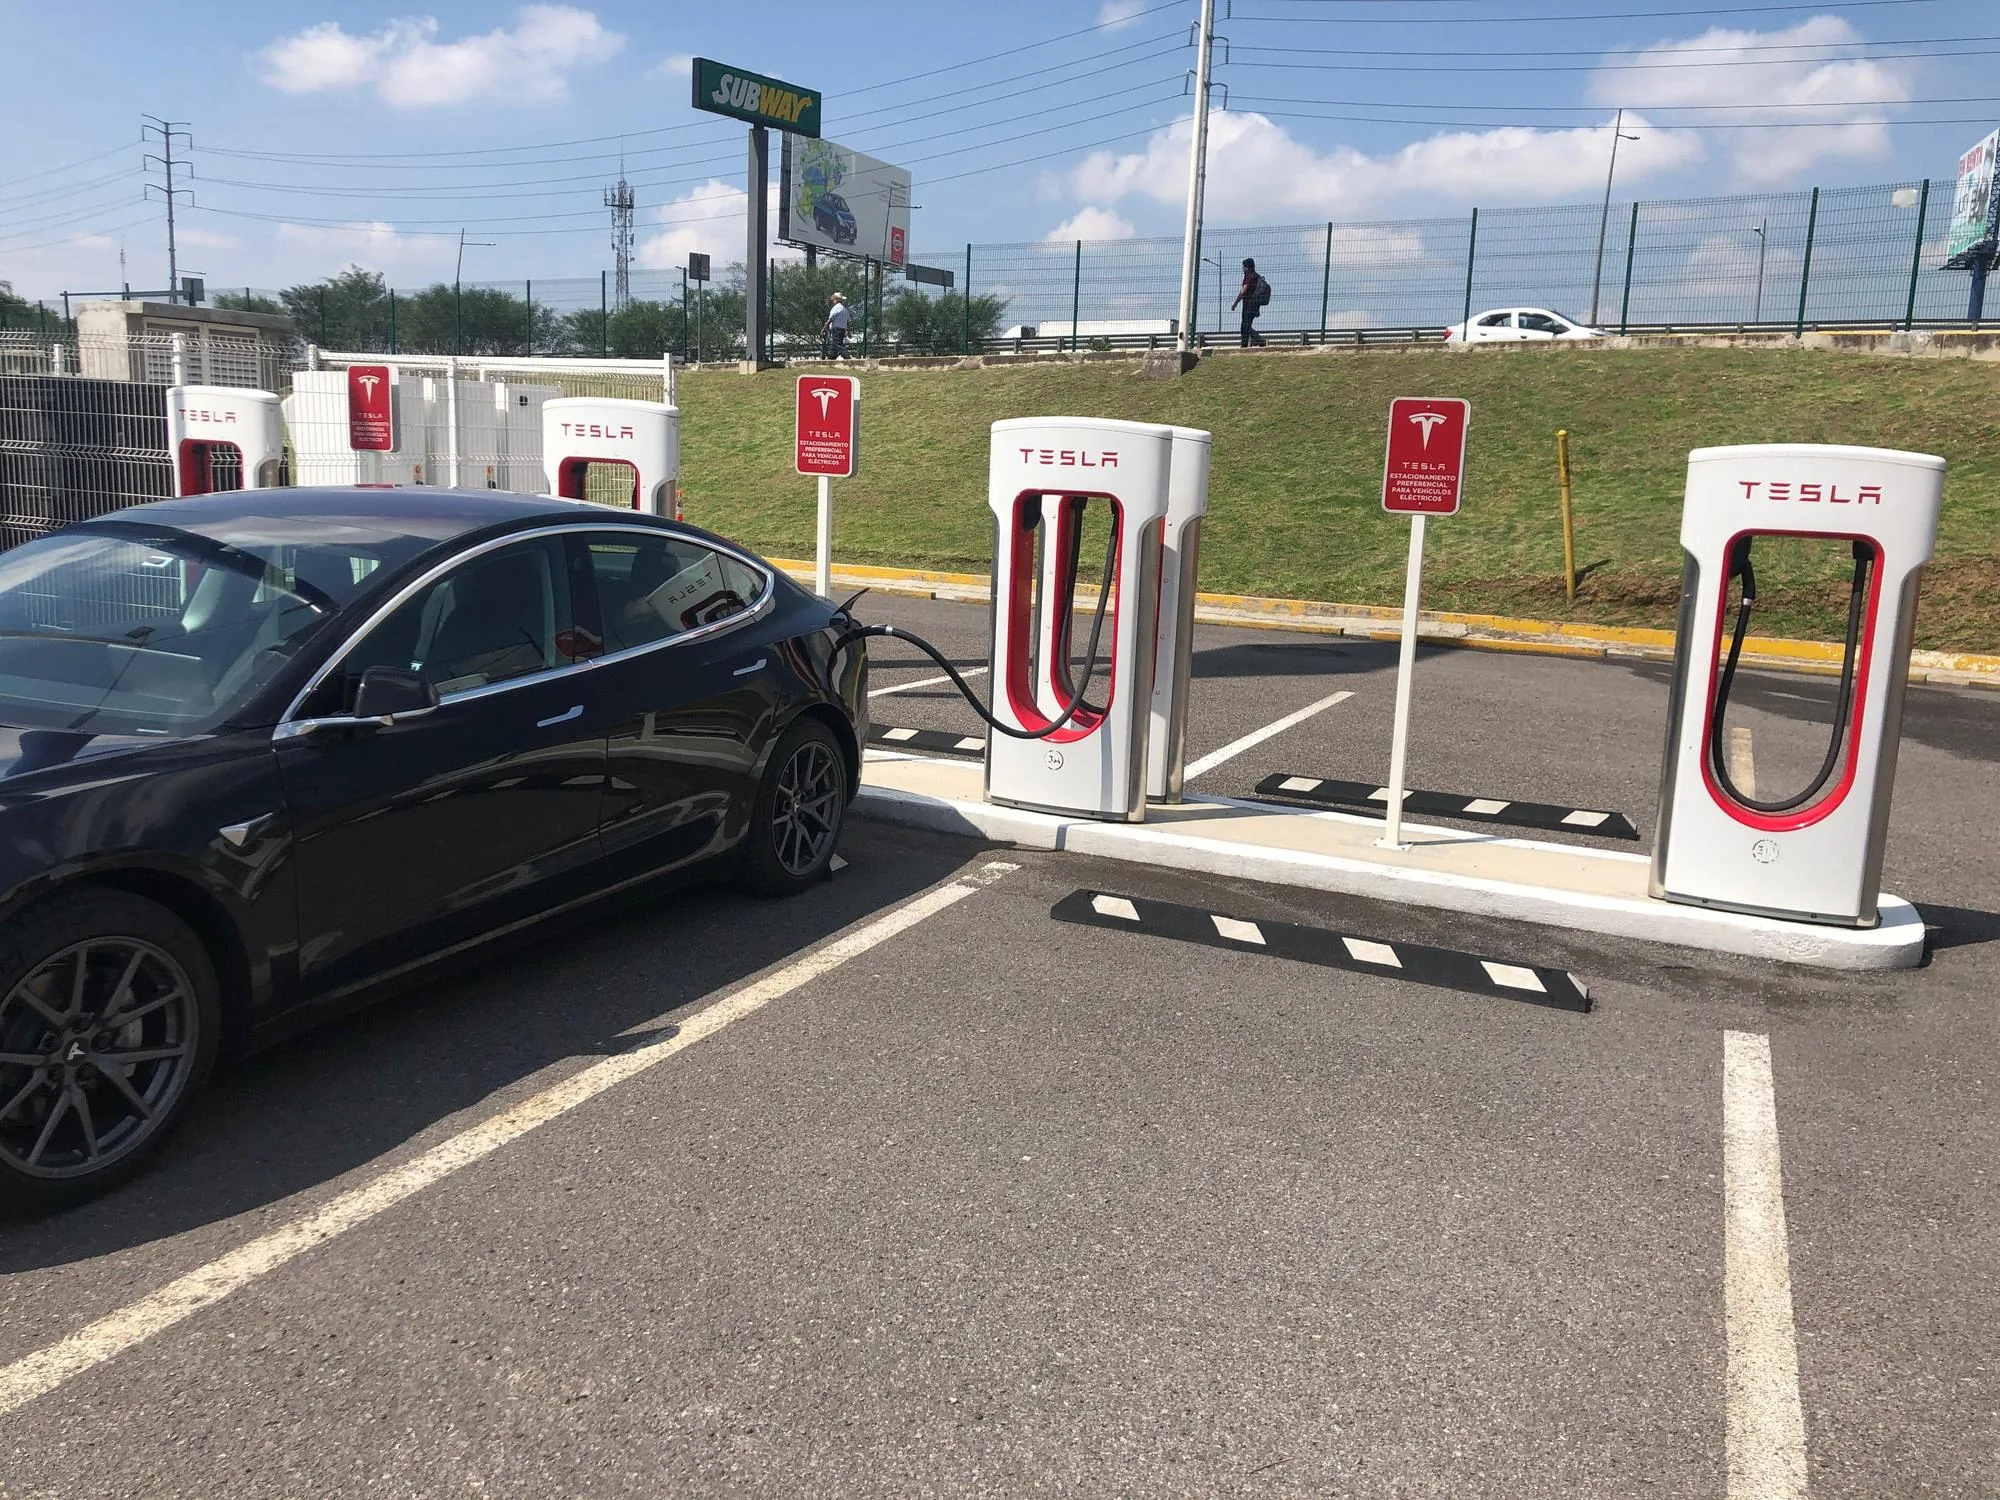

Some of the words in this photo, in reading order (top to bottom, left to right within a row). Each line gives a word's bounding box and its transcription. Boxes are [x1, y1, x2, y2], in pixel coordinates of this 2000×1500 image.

[712, 74, 812, 123] SUBWAY
[179, 409, 236, 423] TESLA
[561, 423, 634, 439] TESLA
[800, 440, 848, 448] ESTACIONAMIENTO
[1019, 448, 1118, 467] TESLA
[1402, 462, 1445, 470] TESLA
[1390, 473, 1456, 481] ESTACIONAMIENTO
[1397, 480, 1448, 488] PREFERENCIAL
[1739, 481, 1882, 505] TESLA
